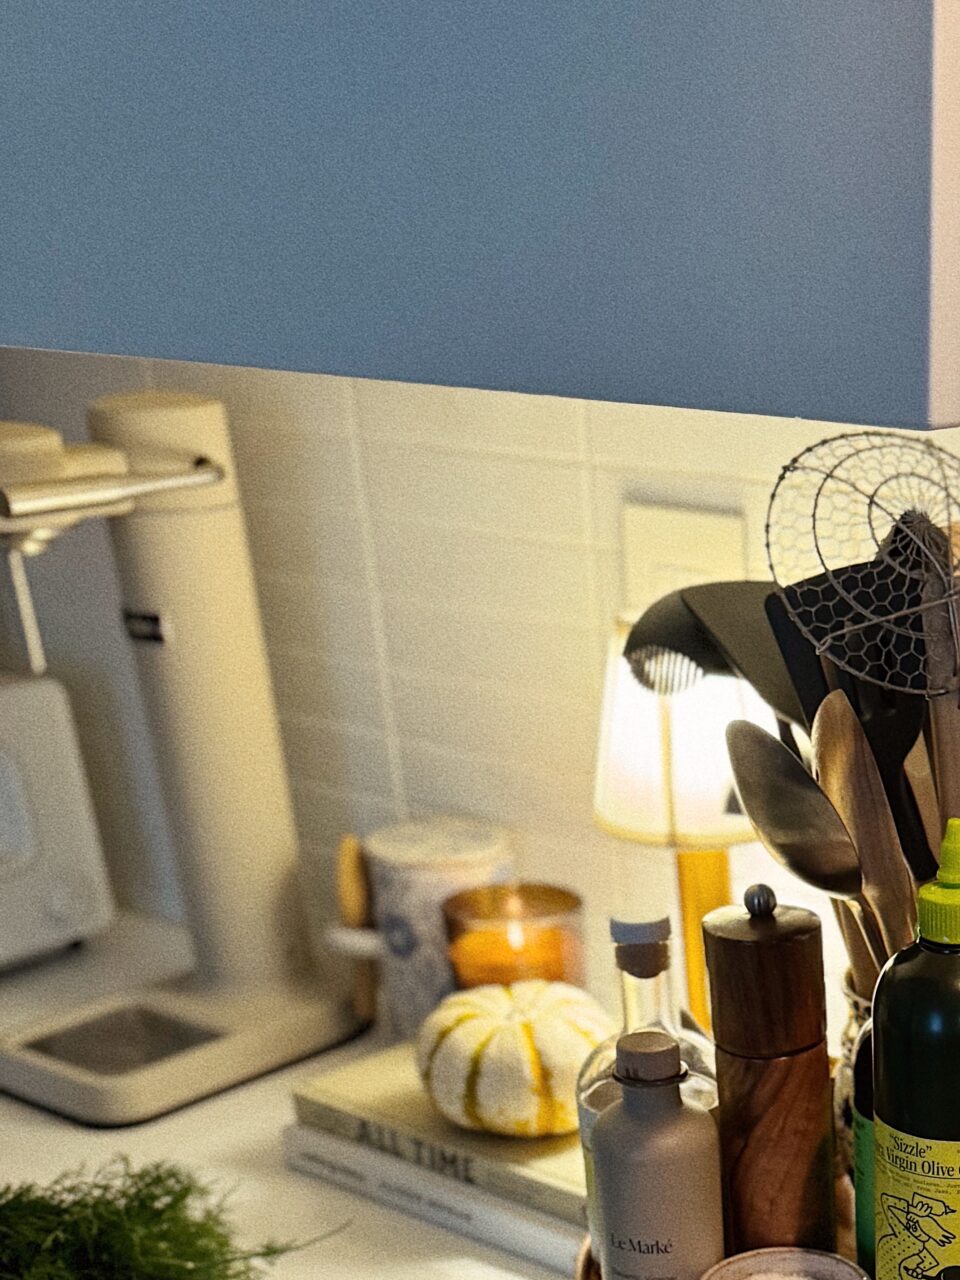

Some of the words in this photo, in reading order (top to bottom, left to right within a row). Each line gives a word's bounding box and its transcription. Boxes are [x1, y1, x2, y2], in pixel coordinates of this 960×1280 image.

[886, 1145, 917, 1172] Virgin
[921, 1160, 955, 1177] Olive
[610, 1234, 627, 1251] Le
[628, 1238, 674, 1255] Marké
